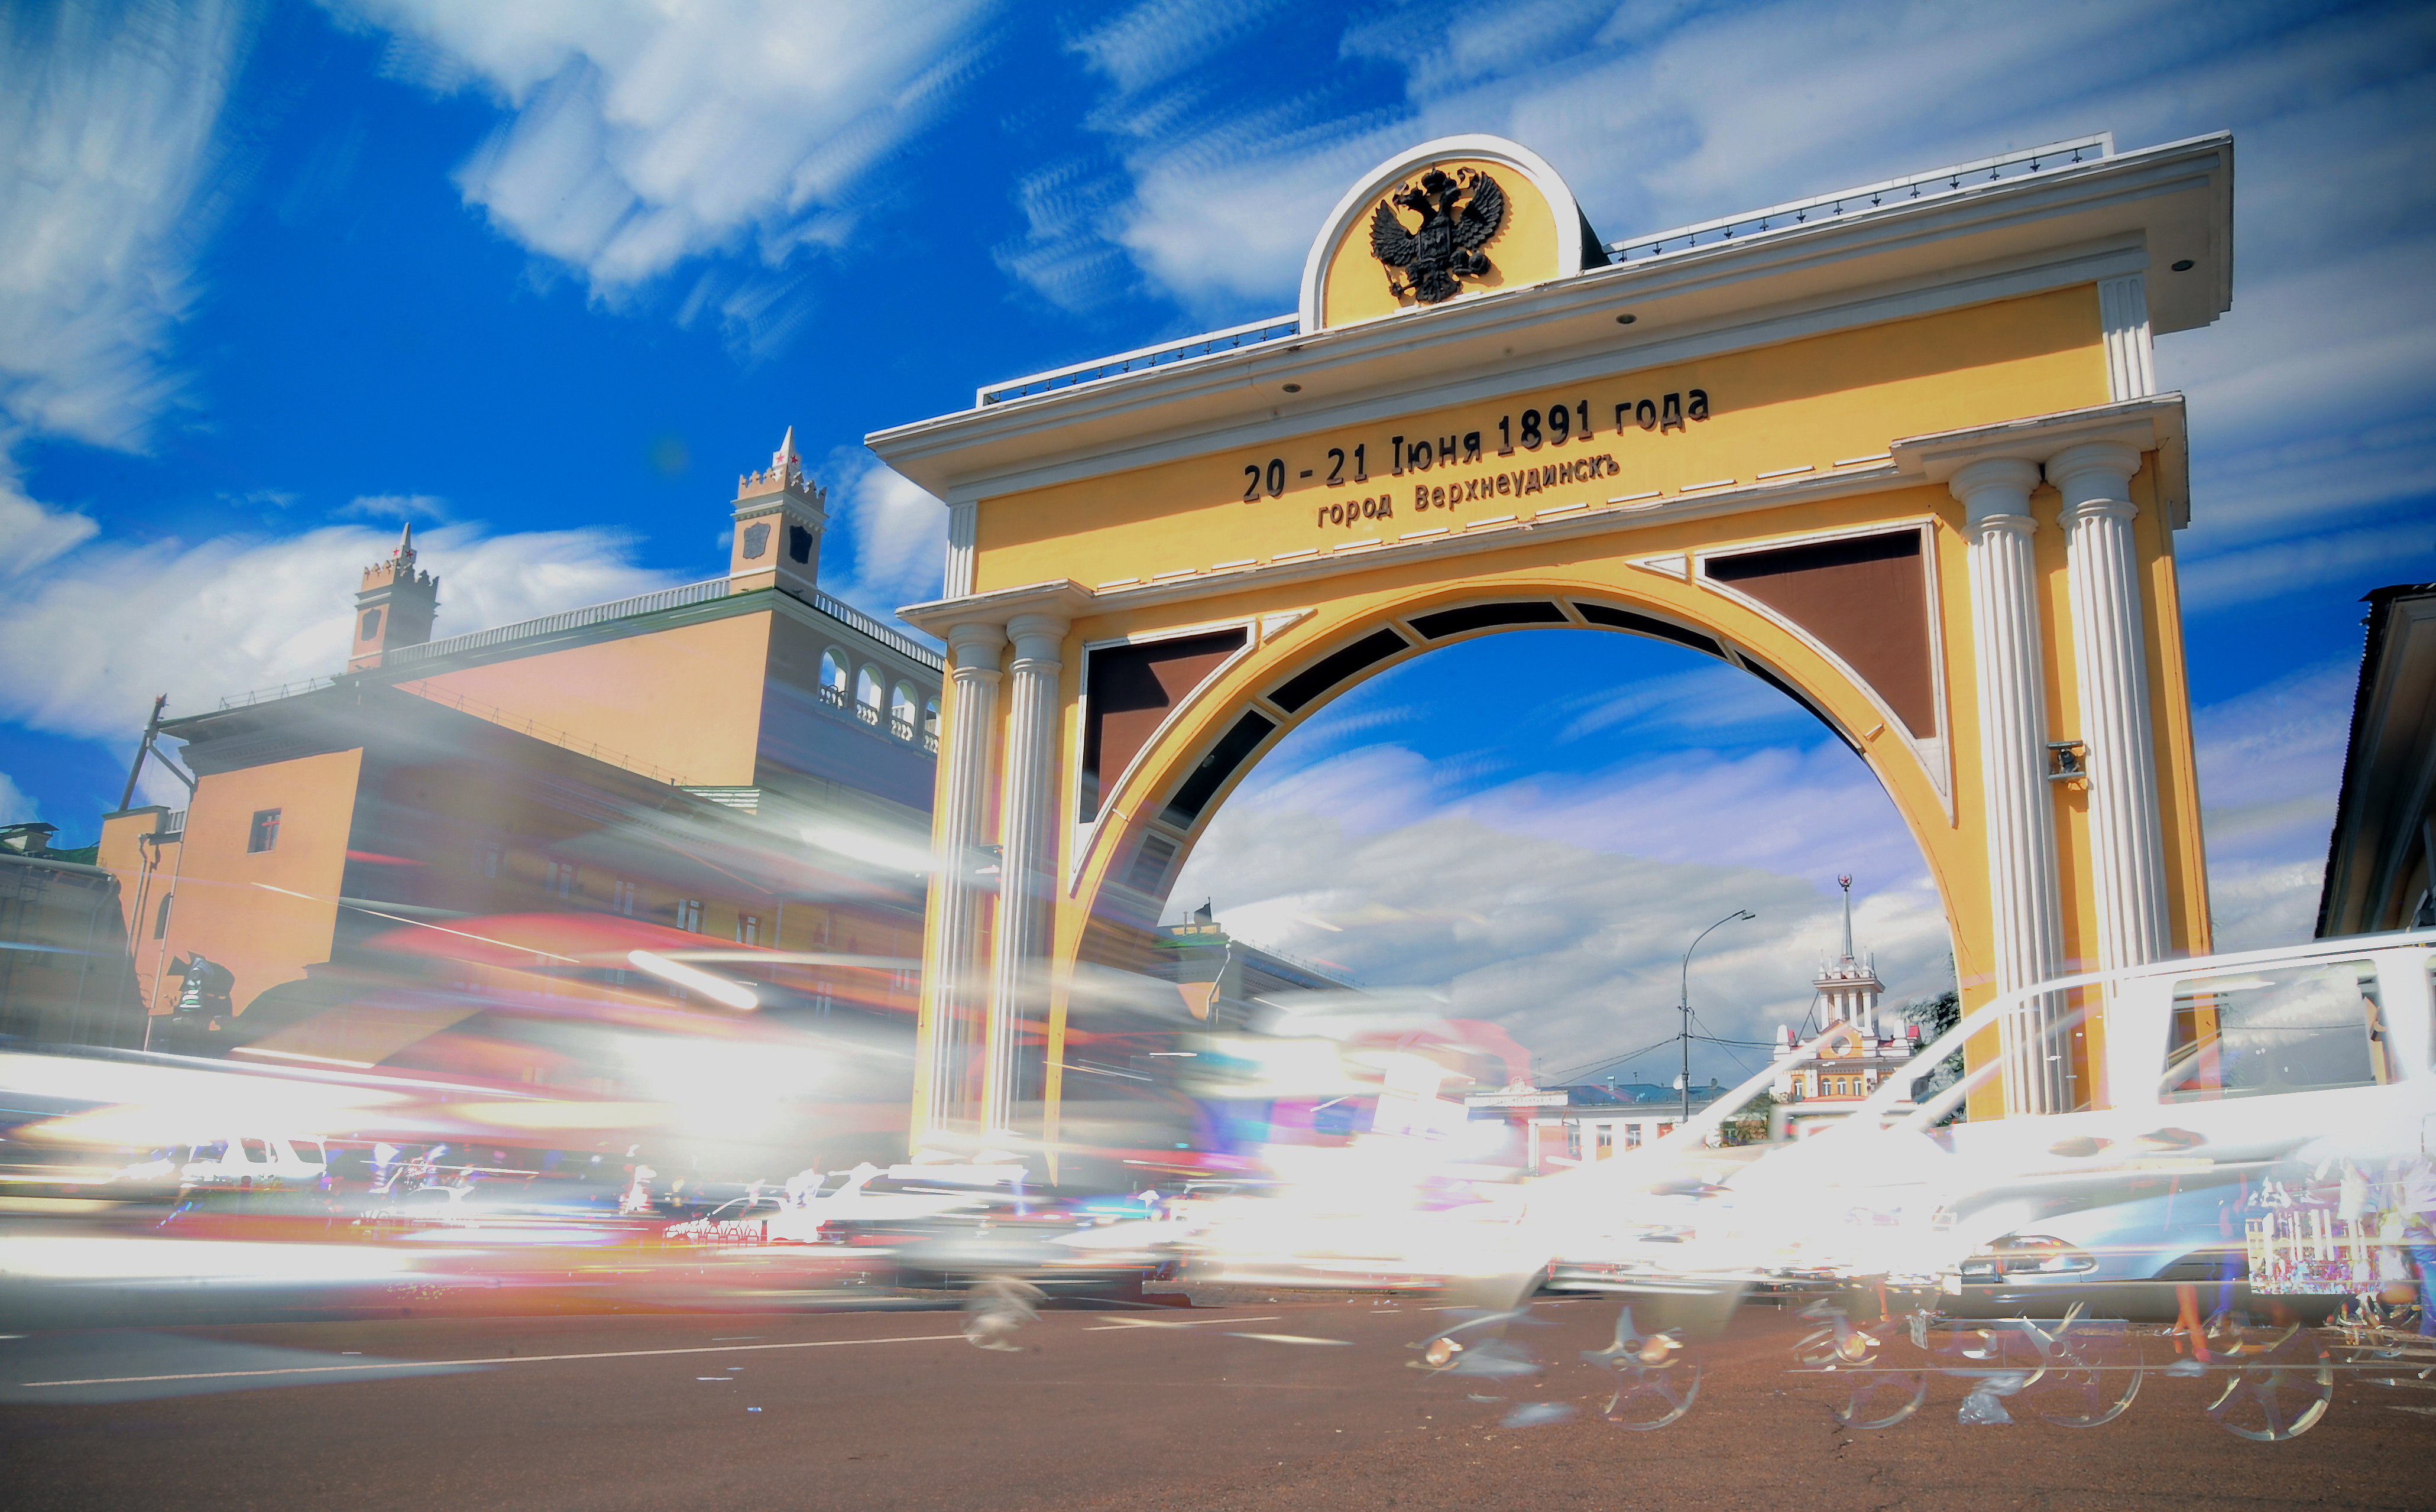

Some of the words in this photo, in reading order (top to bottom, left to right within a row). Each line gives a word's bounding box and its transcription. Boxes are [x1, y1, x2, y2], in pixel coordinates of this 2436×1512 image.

[1243, 459, 1285, 503] 20
[1326, 446, 1368, 487] 21
[1498, 400, 1594, 457] 1891
[1615, 389, 1710, 436] года
[1318, 494, 1393, 528] город
[1415, 453, 1621, 512] Верхнеудинскъ
